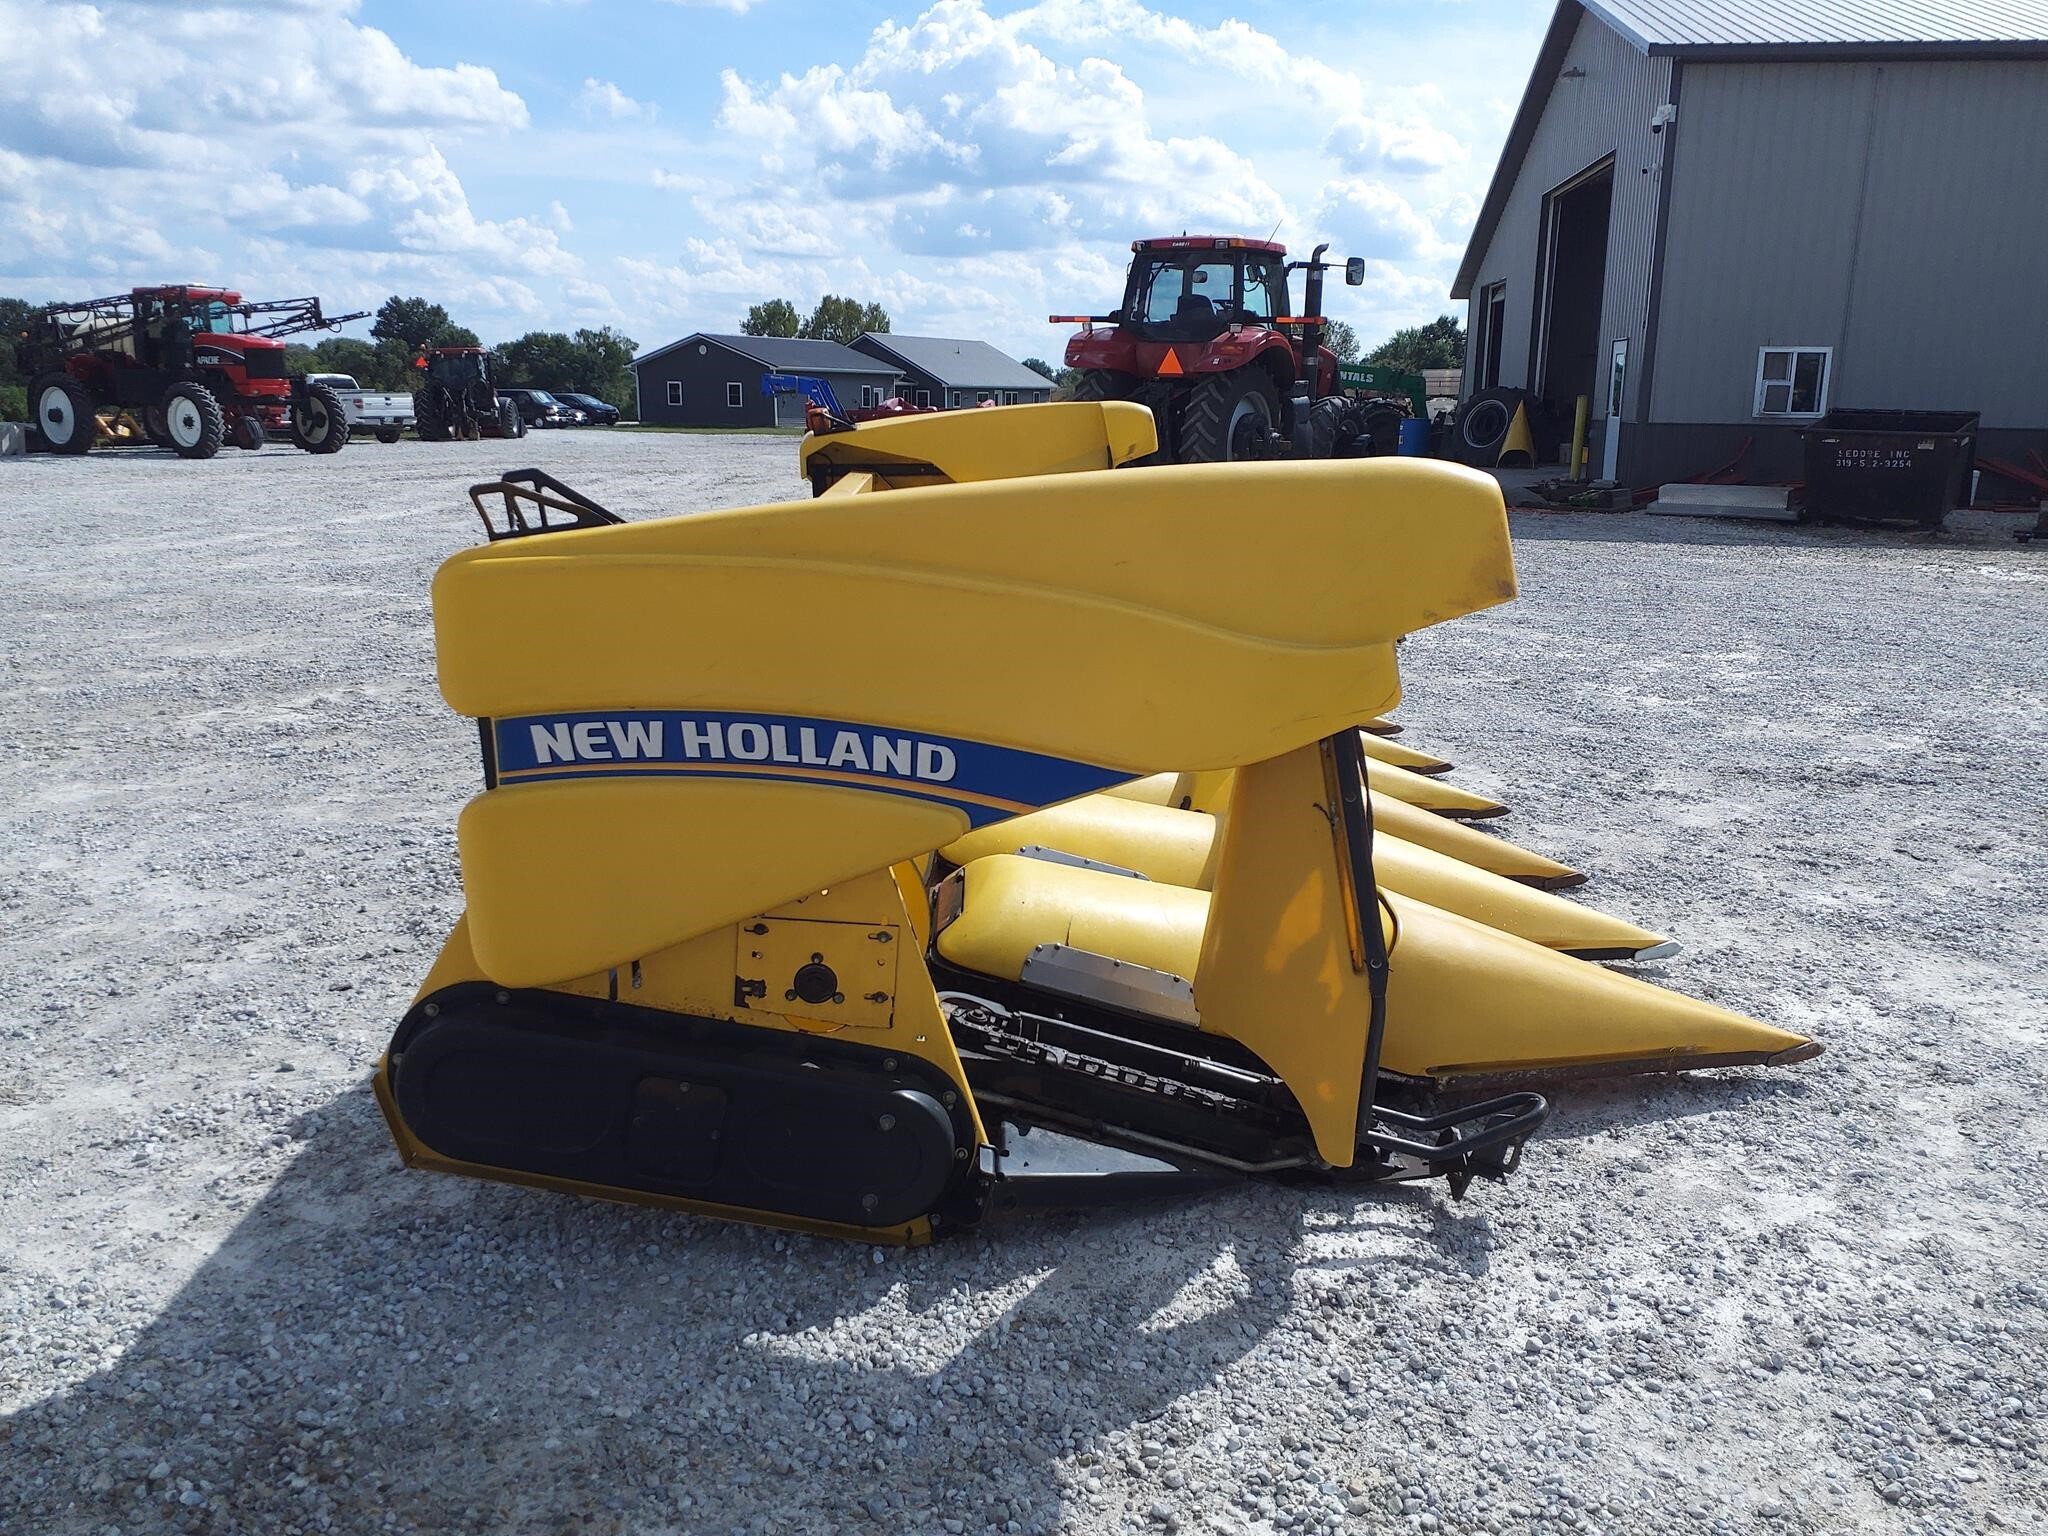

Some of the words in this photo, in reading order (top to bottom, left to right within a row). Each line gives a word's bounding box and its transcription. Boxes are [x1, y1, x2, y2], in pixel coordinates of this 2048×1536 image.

[1890, 449, 1911, 458] INC
[1836, 459, 1912, 468] 319-52-3254
[529, 720, 664, 764] NEW
[680, 720, 957, 782] HOLLAND
